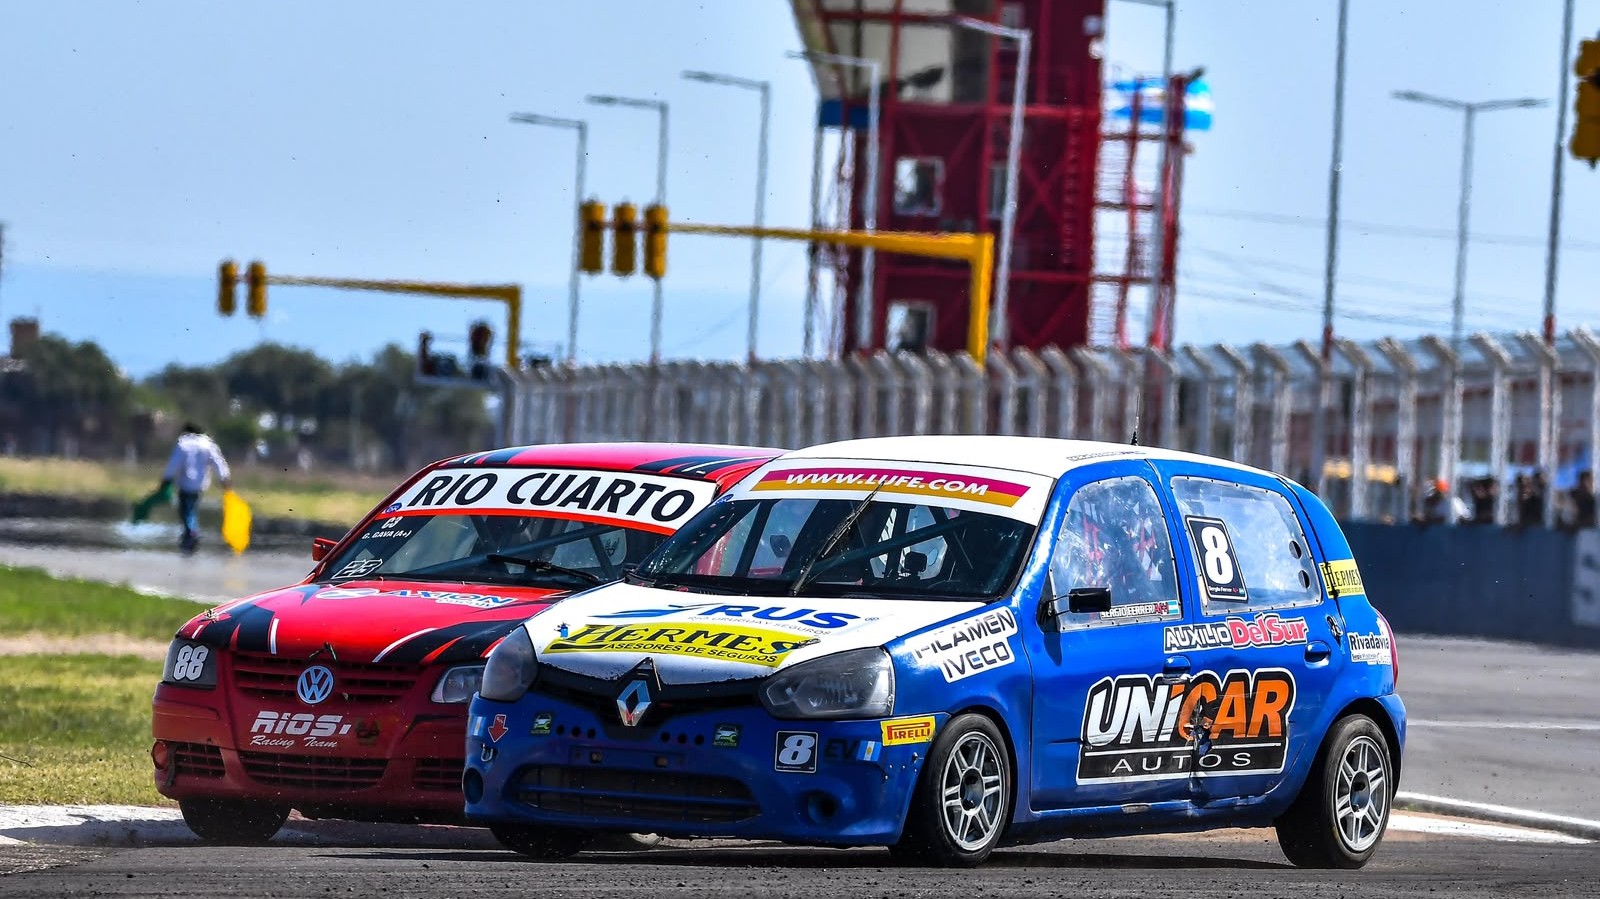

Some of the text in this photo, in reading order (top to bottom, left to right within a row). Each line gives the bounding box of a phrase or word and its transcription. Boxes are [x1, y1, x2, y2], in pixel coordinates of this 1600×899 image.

[407, 472, 695, 522] RIO CUARTO
[785, 473, 989, 496] WWW.LUFE.COM
[1200, 526, 1234, 585] 8
[1320, 563, 1362, 589] HERMES
[697, 604, 861, 629] RUS
[566, 624, 798, 655] HERMES
[1165, 624, 1232, 650] AUXILIO
[1349, 634, 1389, 650] Rivadavia
[173, 645, 209, 681] 88
[606, 643, 778, 663] ASESORES DE SEGUROS
[942, 641, 1010, 679] IVECO
[249, 735, 338, 749] Racing Team
[886, 721, 931, 741] PIRELLI
[778, 734, 816, 765] 8
[1111, 752, 1251, 774] AUTOS
